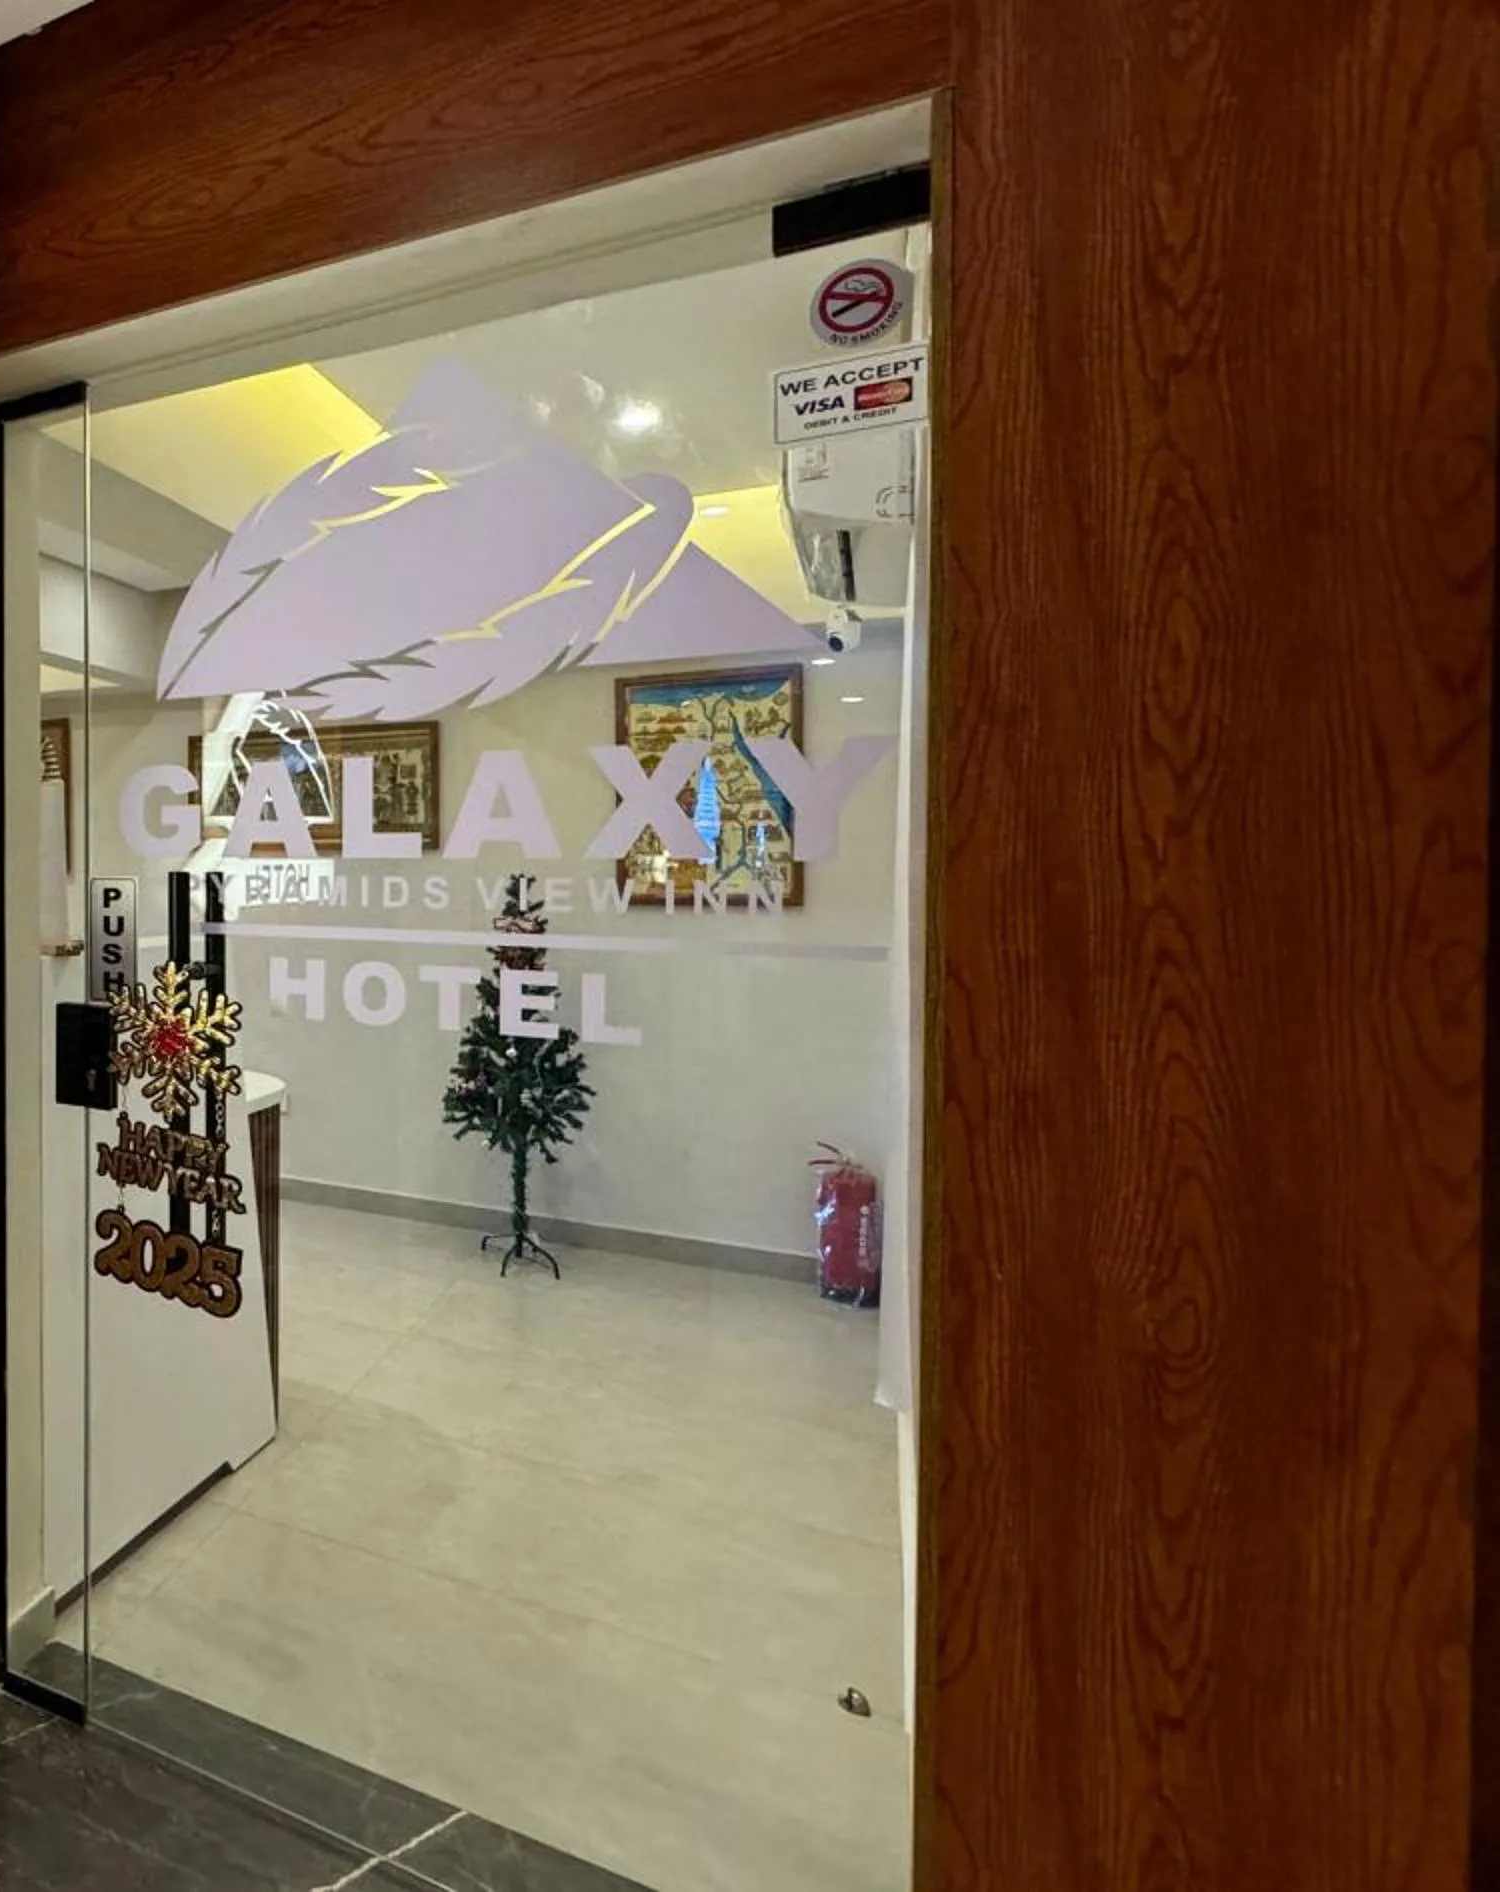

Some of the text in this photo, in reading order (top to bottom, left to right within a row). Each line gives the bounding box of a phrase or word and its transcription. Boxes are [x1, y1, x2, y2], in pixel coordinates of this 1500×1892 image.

[780, 357, 923, 396] WE ACCEPT
[795, 396, 844, 416] VISA
[118, 734, 898, 864] GALAXY
[102, 887, 125, 994] PUSH
[475, 876, 634, 914] VIEW
[665, 879, 784, 915] INN
[268, 956, 642, 1046] HOTEL
[94, 1208, 242, 1319] 2025
